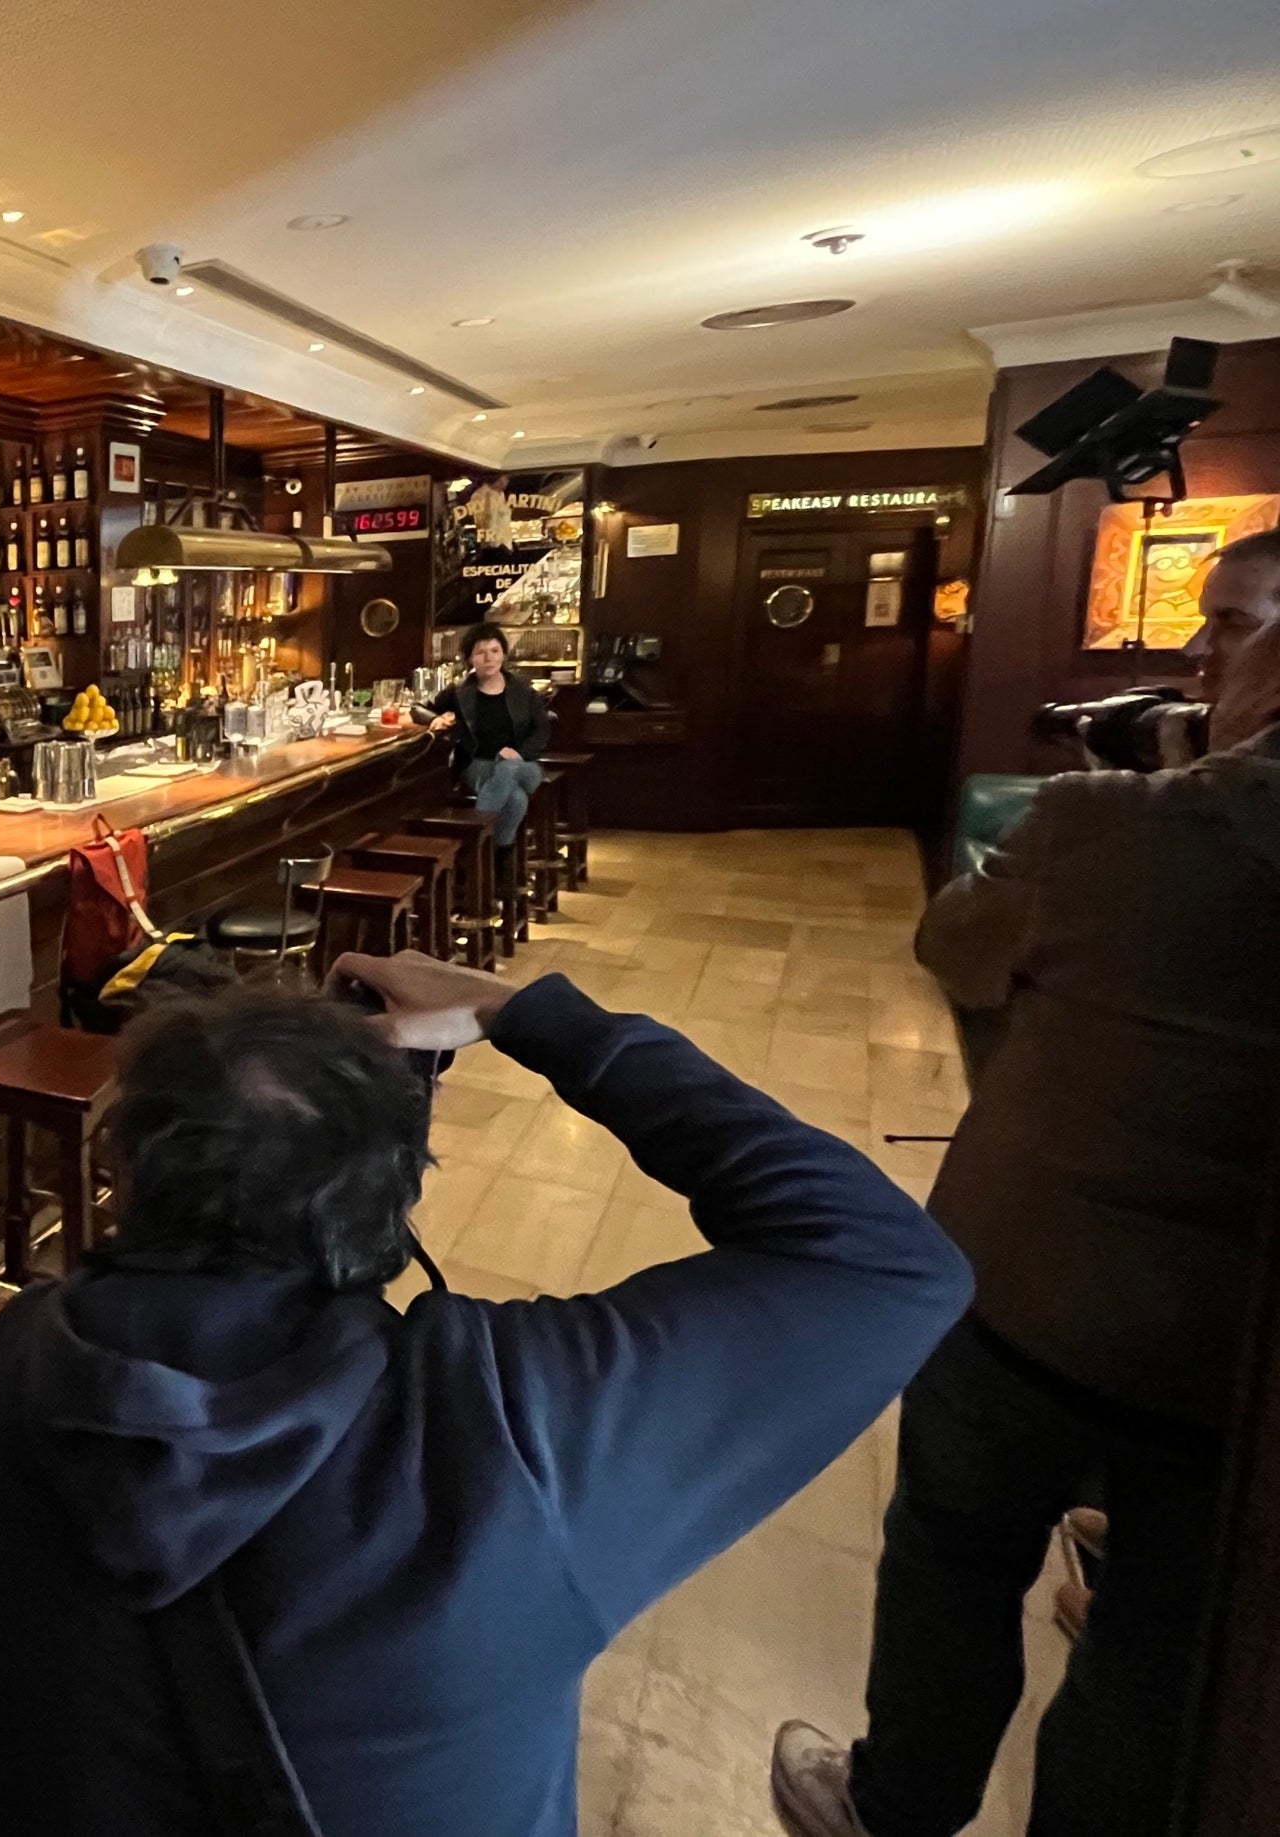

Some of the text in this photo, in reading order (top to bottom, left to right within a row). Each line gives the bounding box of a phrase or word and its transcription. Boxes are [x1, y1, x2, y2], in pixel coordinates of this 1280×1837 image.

[750, 492, 939, 512] SPEAKEASY RESTAURA
[496, 578, 513, 589] DE
[476, 593, 494, 604] LA
